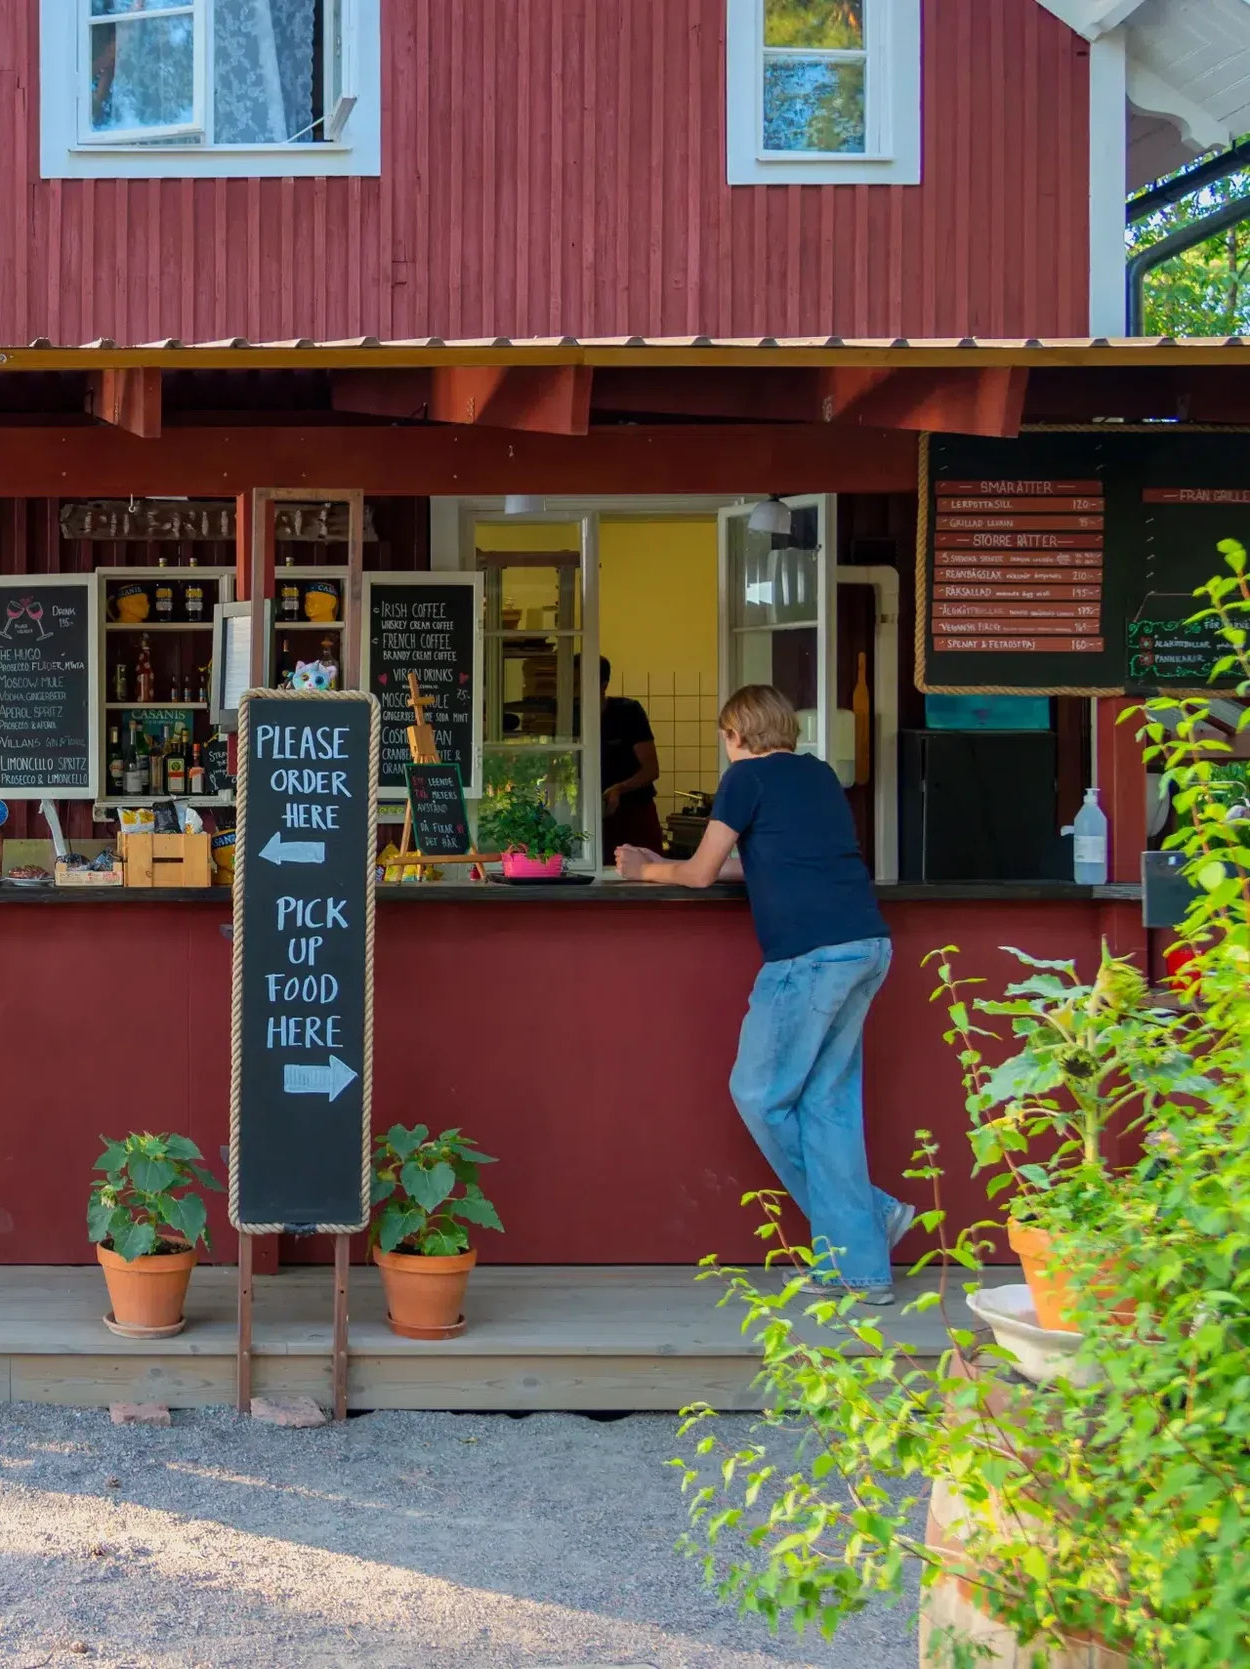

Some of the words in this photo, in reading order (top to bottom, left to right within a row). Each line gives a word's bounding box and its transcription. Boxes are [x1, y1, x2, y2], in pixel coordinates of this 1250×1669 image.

[980, 480, 1053, 494] SMÅRÄTTER
[1179, 488, 1210, 501] FRÅN
[949, 518, 983, 528] GRILLAD
[52, 605, 76, 616] DRINK
[381, 601, 407, 618] IRISH
[412, 603, 447, 618] COFFEE
[381, 620, 407, 630] WHISKEY
[410, 620, 431, 630] CREAM
[432, 621, 454, 630] COFFEE
[383, 632, 416, 649] FRENCH
[420, 634, 452, 649] COFFEE
[947, 639, 978, 649] SPENAT
[14, 648, 41, 660] HUGO
[383, 650, 411, 660] BRANDY
[412, 651, 432, 660] CREAM
[433, 651, 457, 661] COFFEE
[423, 668, 454, 682] DRINKS
[41, 676, 65, 688] MULE
[382, 692, 413, 708] MOSCO
[0, 705, 32, 718] APEROL
[33, 706, 63, 718] SPRITZ
[131, 709, 186, 720] CASANIS
[382, 710, 415, 722] GINGERBEE
[435, 712, 449, 722] SODA
[453, 712, 469, 723] MINT
[0, 735, 41, 748] VILLANS
[255, 724, 350, 760] PLEASE
[382, 748, 412, 760] CRANBE
[0, 755, 53, 771] LIMONCELLO
[58, 757, 87, 771] SPRITZ
[382, 762, 406, 775] ORAN
[1, 773, 36, 785] PROSECCO
[37, 774, 44, 784] &
[47, 773, 88, 784] LIMONCELLO
[270, 768, 352, 798] ORDER
[427, 777, 454, 786] LEENDE
[432, 790, 457, 800] METERS
[417, 800, 448, 813] AVSTÅND
[281, 803, 340, 830] HERE
[432, 822, 454, 834] FIXAR
[276, 895, 349, 932] PICK
[288, 936, 324, 967] UP
[264, 972, 339, 1004] FOOD
[266, 1014, 344, 1049] HERE
